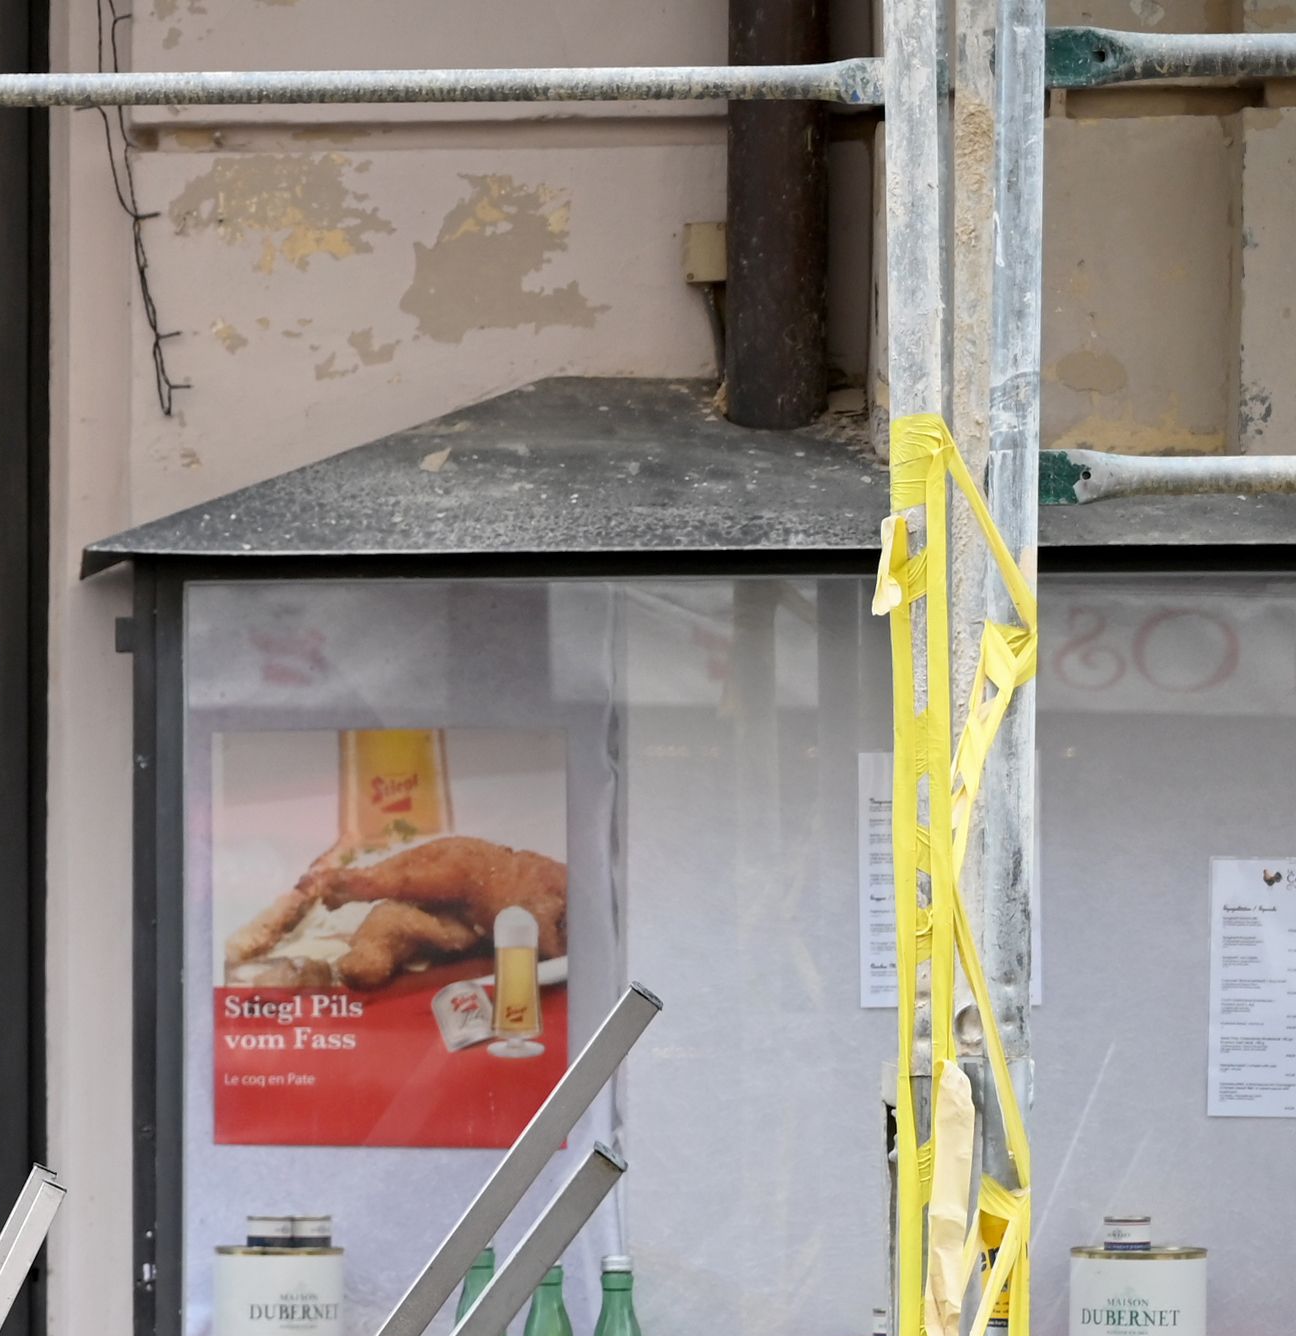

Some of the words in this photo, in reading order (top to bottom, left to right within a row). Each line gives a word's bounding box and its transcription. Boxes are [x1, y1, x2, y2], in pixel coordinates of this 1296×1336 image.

[224, 994, 303, 1025] Stiegl
[311, 994, 364, 1018] Pils
[224, 1034, 286, 1050] vom
[294, 1026, 357, 1050] Fass
[224, 1073, 239, 1085] Le
[241, 1075, 266, 1087] coq
[268, 1075, 286, 1085] en
[287, 1072, 316, 1085] Pate
[1106, 1298, 1150, 1307] MAISON
[248, 1303, 339, 1321] DUBERNET
[1081, 1308, 1181, 1327] DUBERNET
